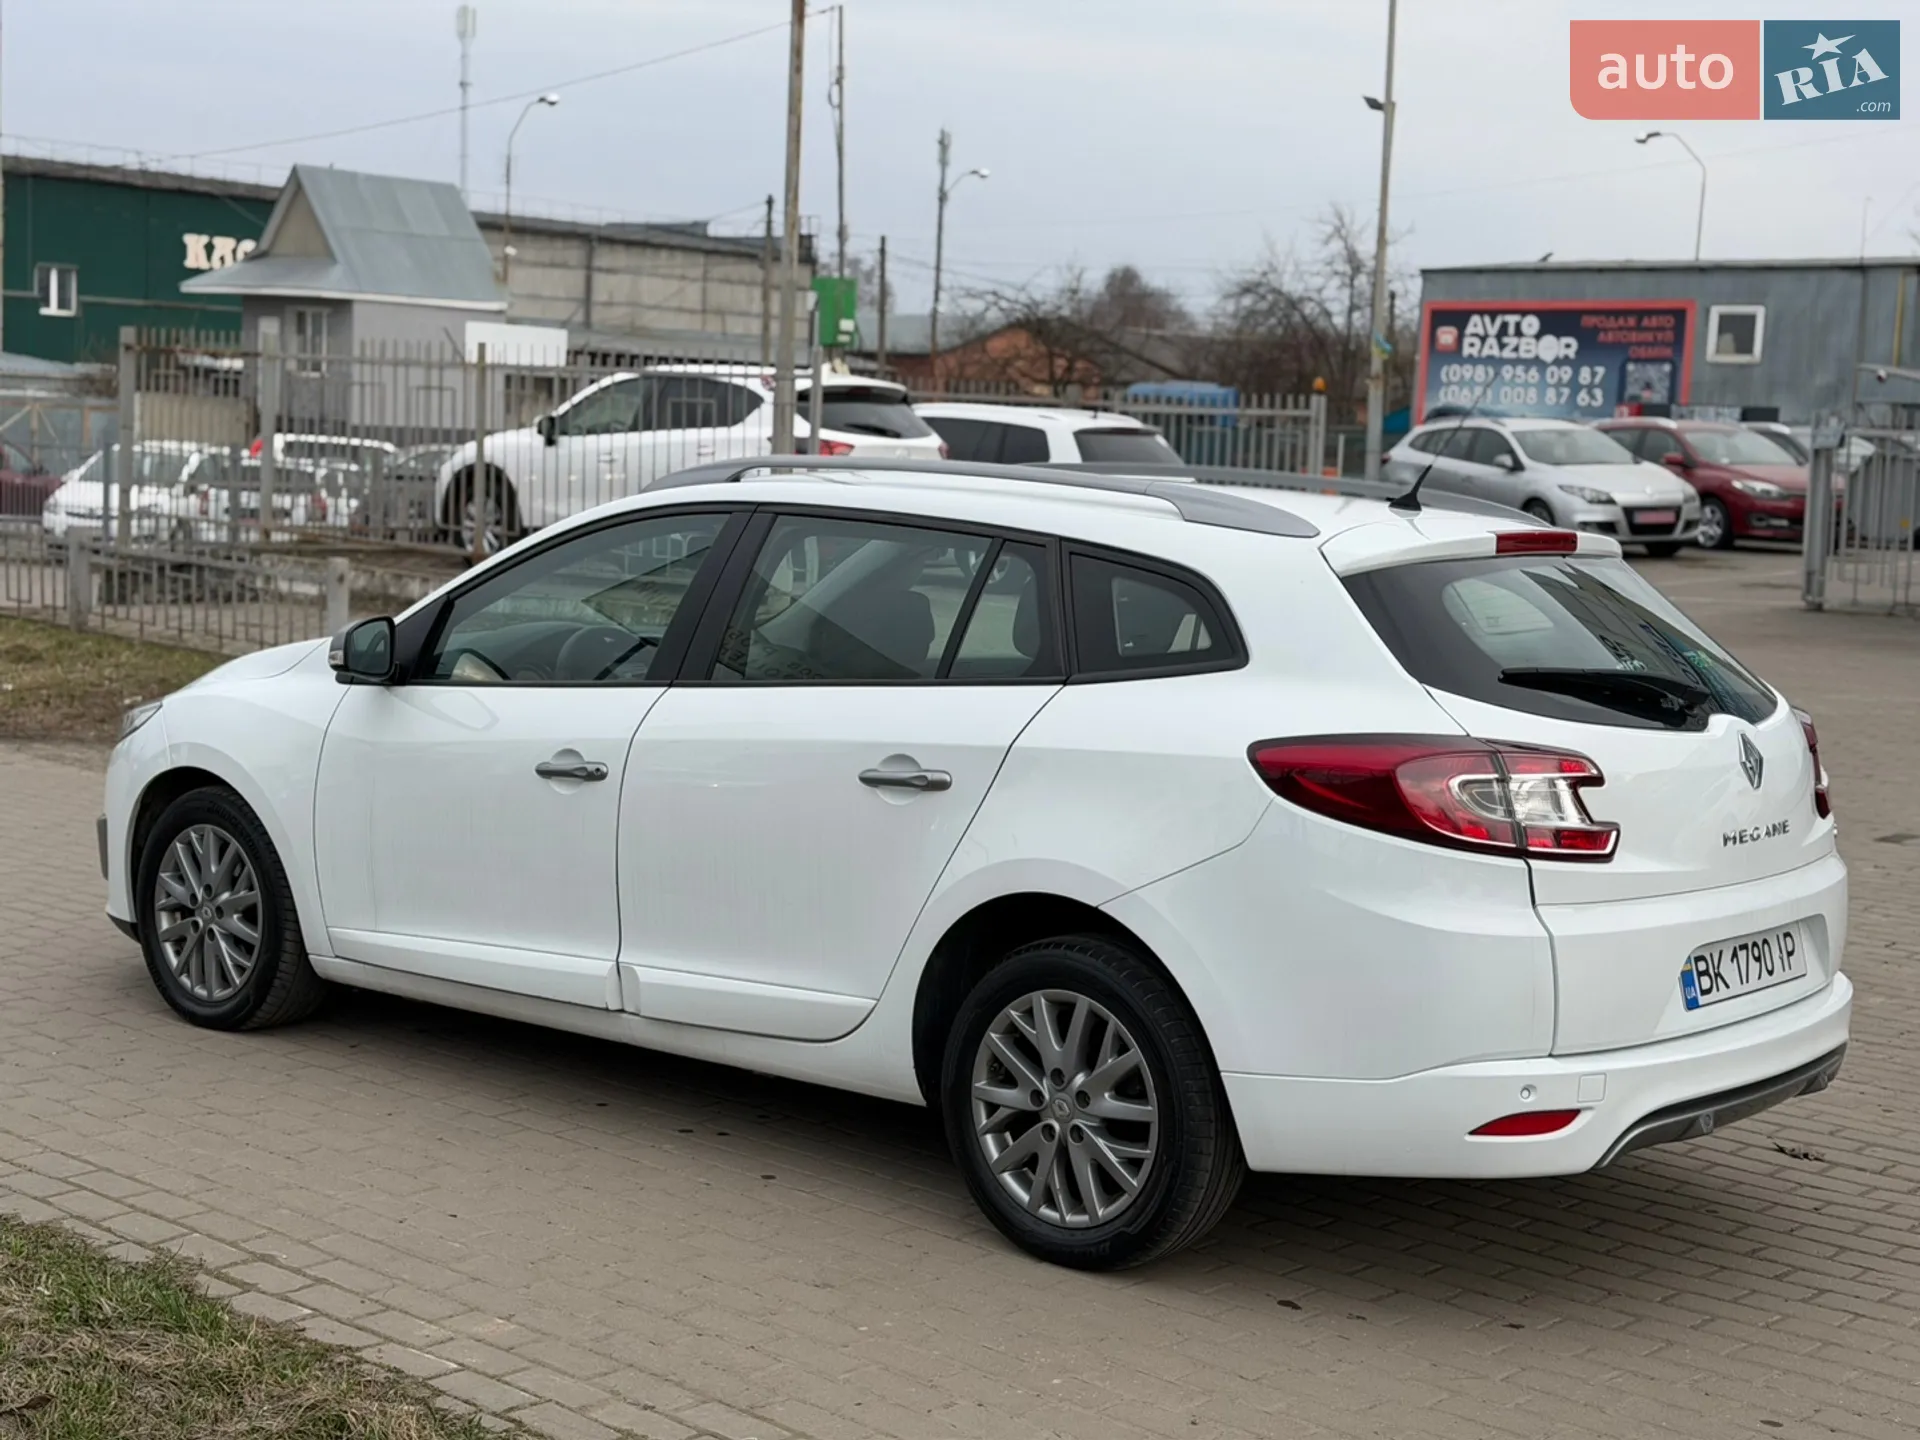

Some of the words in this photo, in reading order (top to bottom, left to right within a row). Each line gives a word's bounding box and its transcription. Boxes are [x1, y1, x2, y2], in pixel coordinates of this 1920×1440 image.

[1464, 314, 1540, 337] AVTO
[1501, 365, 1540, 384] 956
[1545, 365, 1573, 384] 09
[1578, 366, 1606, 385] 87
[1576, 388, 1604, 407] 63
[1722, 820, 1790, 847] MEGANE
[1694, 949, 1731, 996] BK
[1731, 938, 1775, 985] 1790
[1776, 931, 1796, 972] IP
